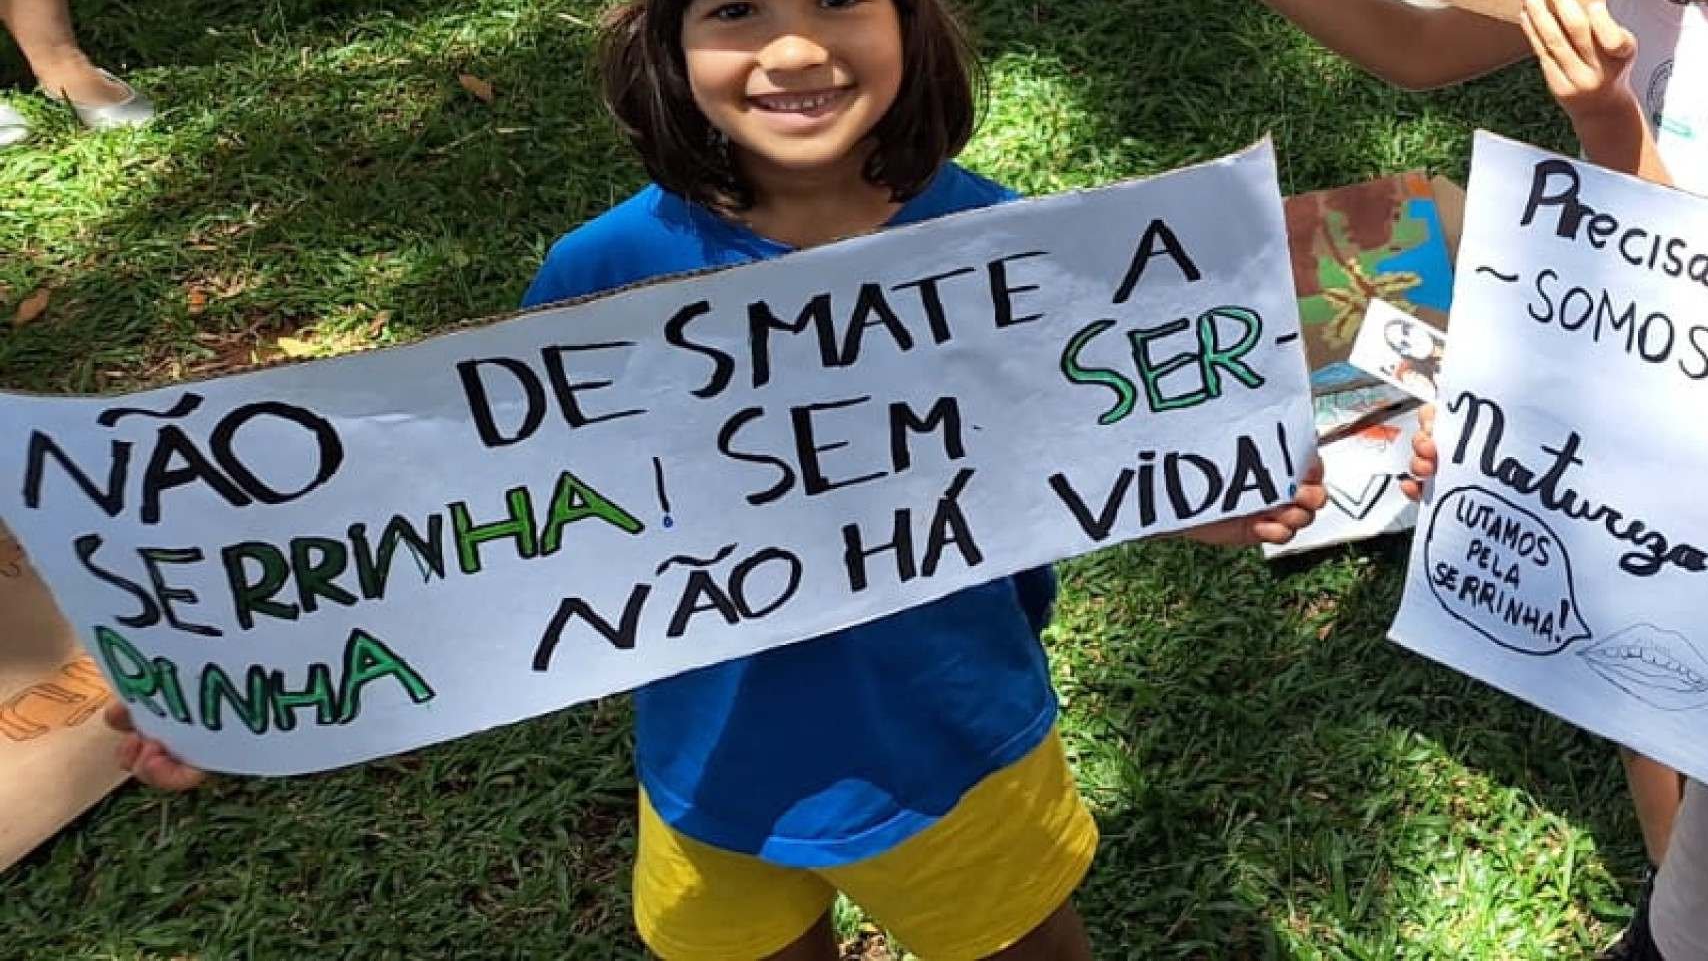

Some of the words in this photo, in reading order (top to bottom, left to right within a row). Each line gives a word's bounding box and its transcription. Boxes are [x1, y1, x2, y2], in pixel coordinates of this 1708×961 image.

[22, 392, 344, 525] NÃO
[456, 250, 1050, 447] DESMATE
[1112, 219, 1202, 304] A
[716, 395, 965, 506] SEM
[1060, 305, 1300, 426] SER-
[532, 543, 802, 672] NÃO
[841, 467, 985, 592] HÁ
[1456, 493, 1551, 567] LUTAMOS
[1466, 538, 1520, 589] PELA
[1432, 562, 1570, 644] SERRINHA!
